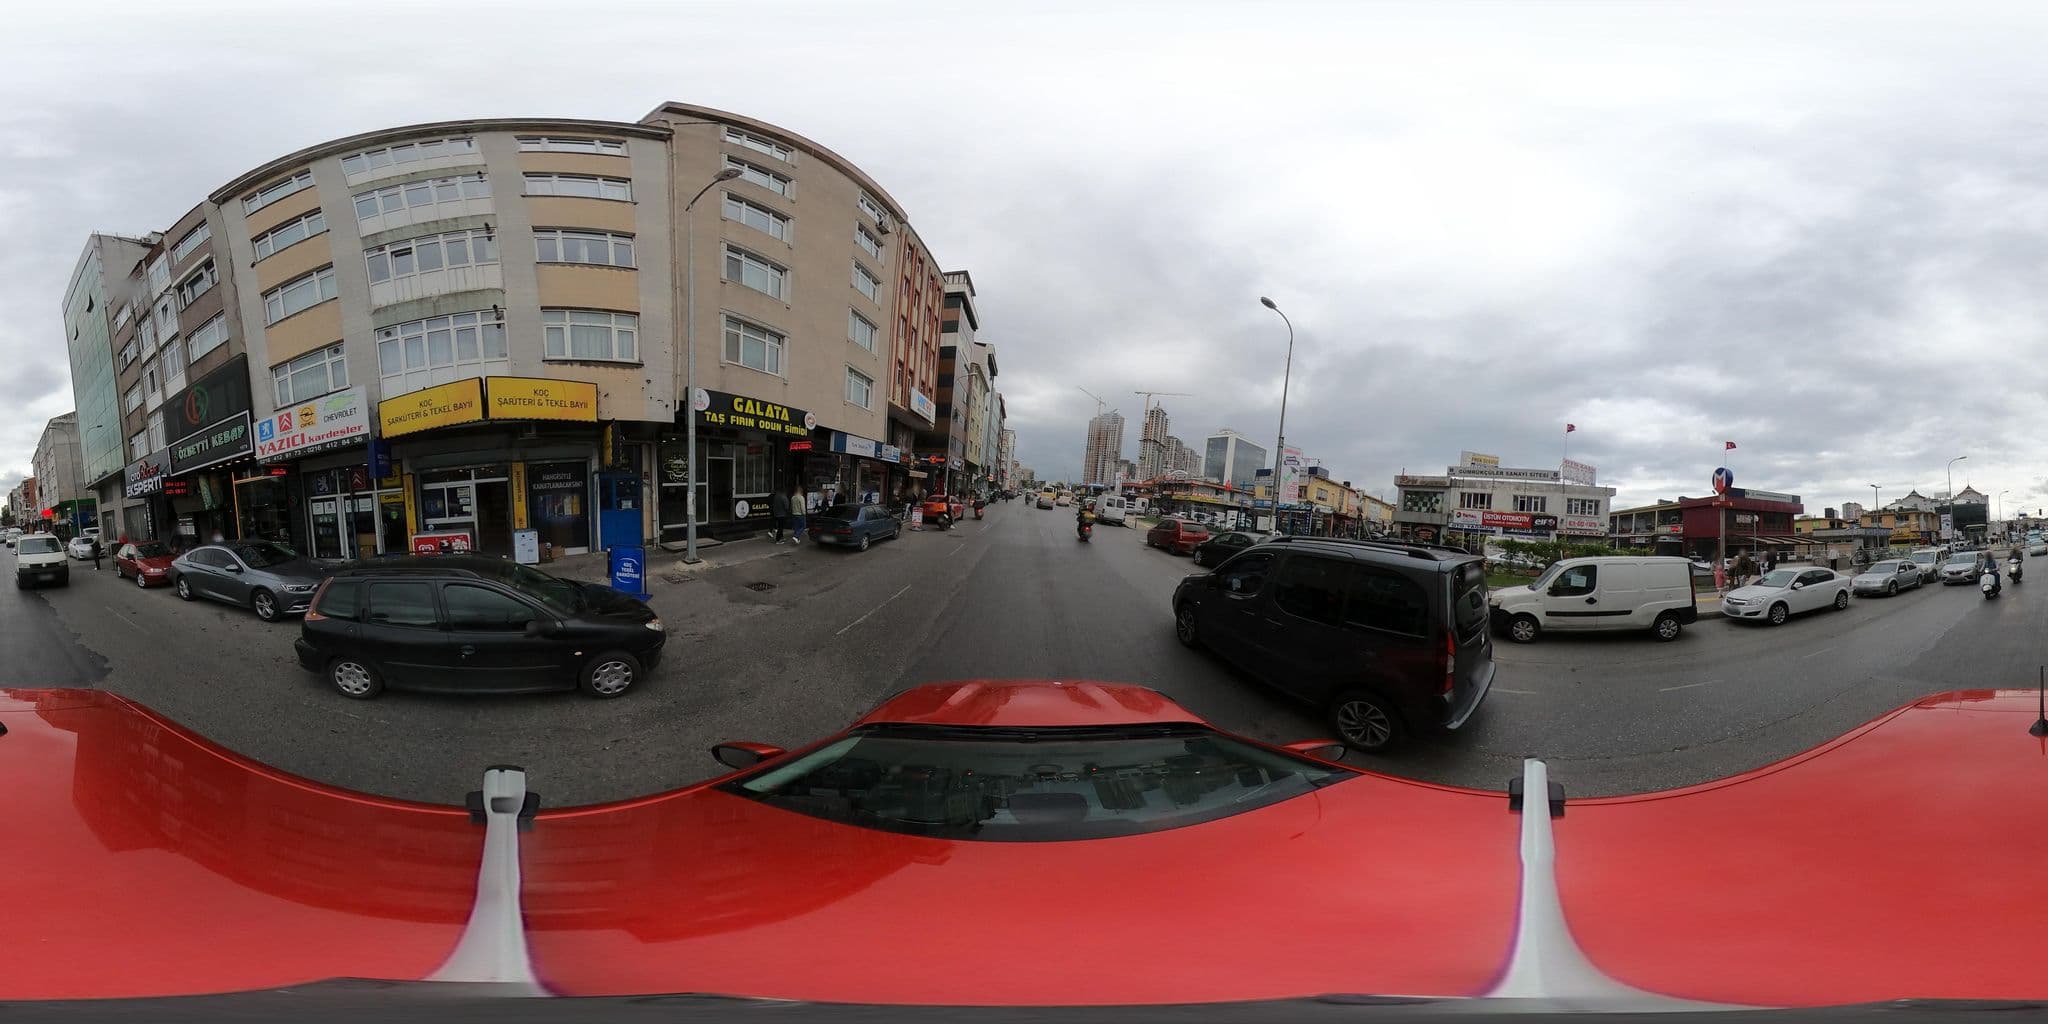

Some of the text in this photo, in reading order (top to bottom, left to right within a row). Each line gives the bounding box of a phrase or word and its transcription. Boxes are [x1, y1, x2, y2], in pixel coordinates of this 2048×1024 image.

[533, 388, 549, 398] KOÇ
[419, 399, 433, 408] KOÇ
[545, 399, 569, 408] TEKEL
[733, 397, 789, 421] GALATA
[324, 407, 357, 423] CHEVROLET
[422, 409, 429, 417] &
[430, 404, 452, 416] TEKEL
[704, 411, 726, 425] TAŞ
[730, 415, 755, 427] FIRIN
[759, 420, 782, 432] ODUN
[179, 425, 245, 460] ÖZBEYTİ KEBAP
[258, 432, 306, 456] YAZICI
[1484, 512, 1501, 520] ÜSTÜN
[1534, 518, 1547, 526] elf
